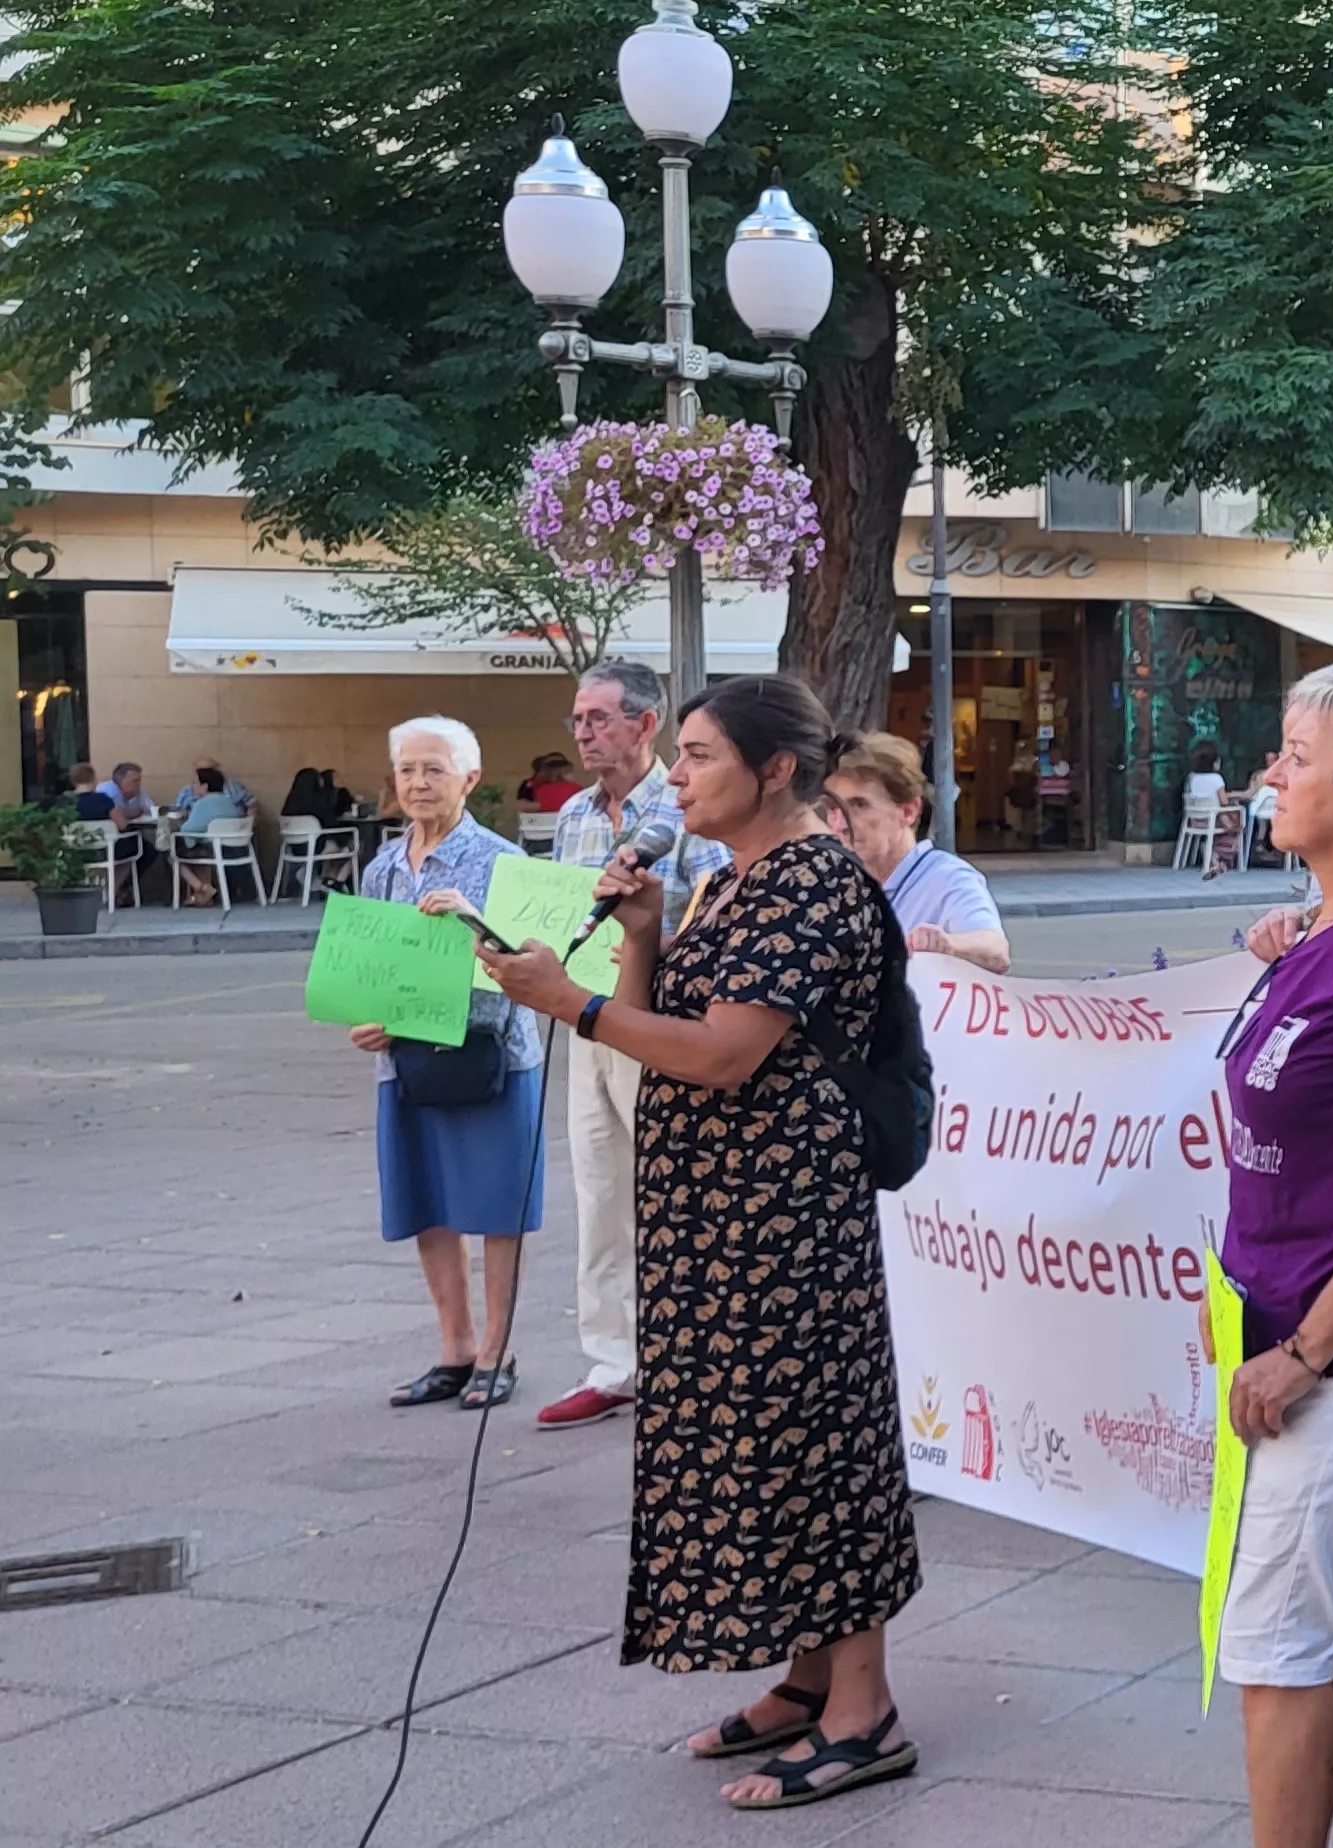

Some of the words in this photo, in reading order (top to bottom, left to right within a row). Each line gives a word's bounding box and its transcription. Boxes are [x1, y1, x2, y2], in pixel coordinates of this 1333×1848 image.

[906, 522, 1096, 578] Bar
[489, 655, 564, 669] GRANJA
[933, 981, 957, 1033] 7
[965, 982, 1010, 1036] DE
[1016, 992, 1173, 1042] OCTUBRE
[985, 1091, 1097, 1165] unida
[1096, 1113, 1167, 1187] por
[1178, 1090, 1231, 1170] el
[902, 1199, 1006, 1293] trabajo
